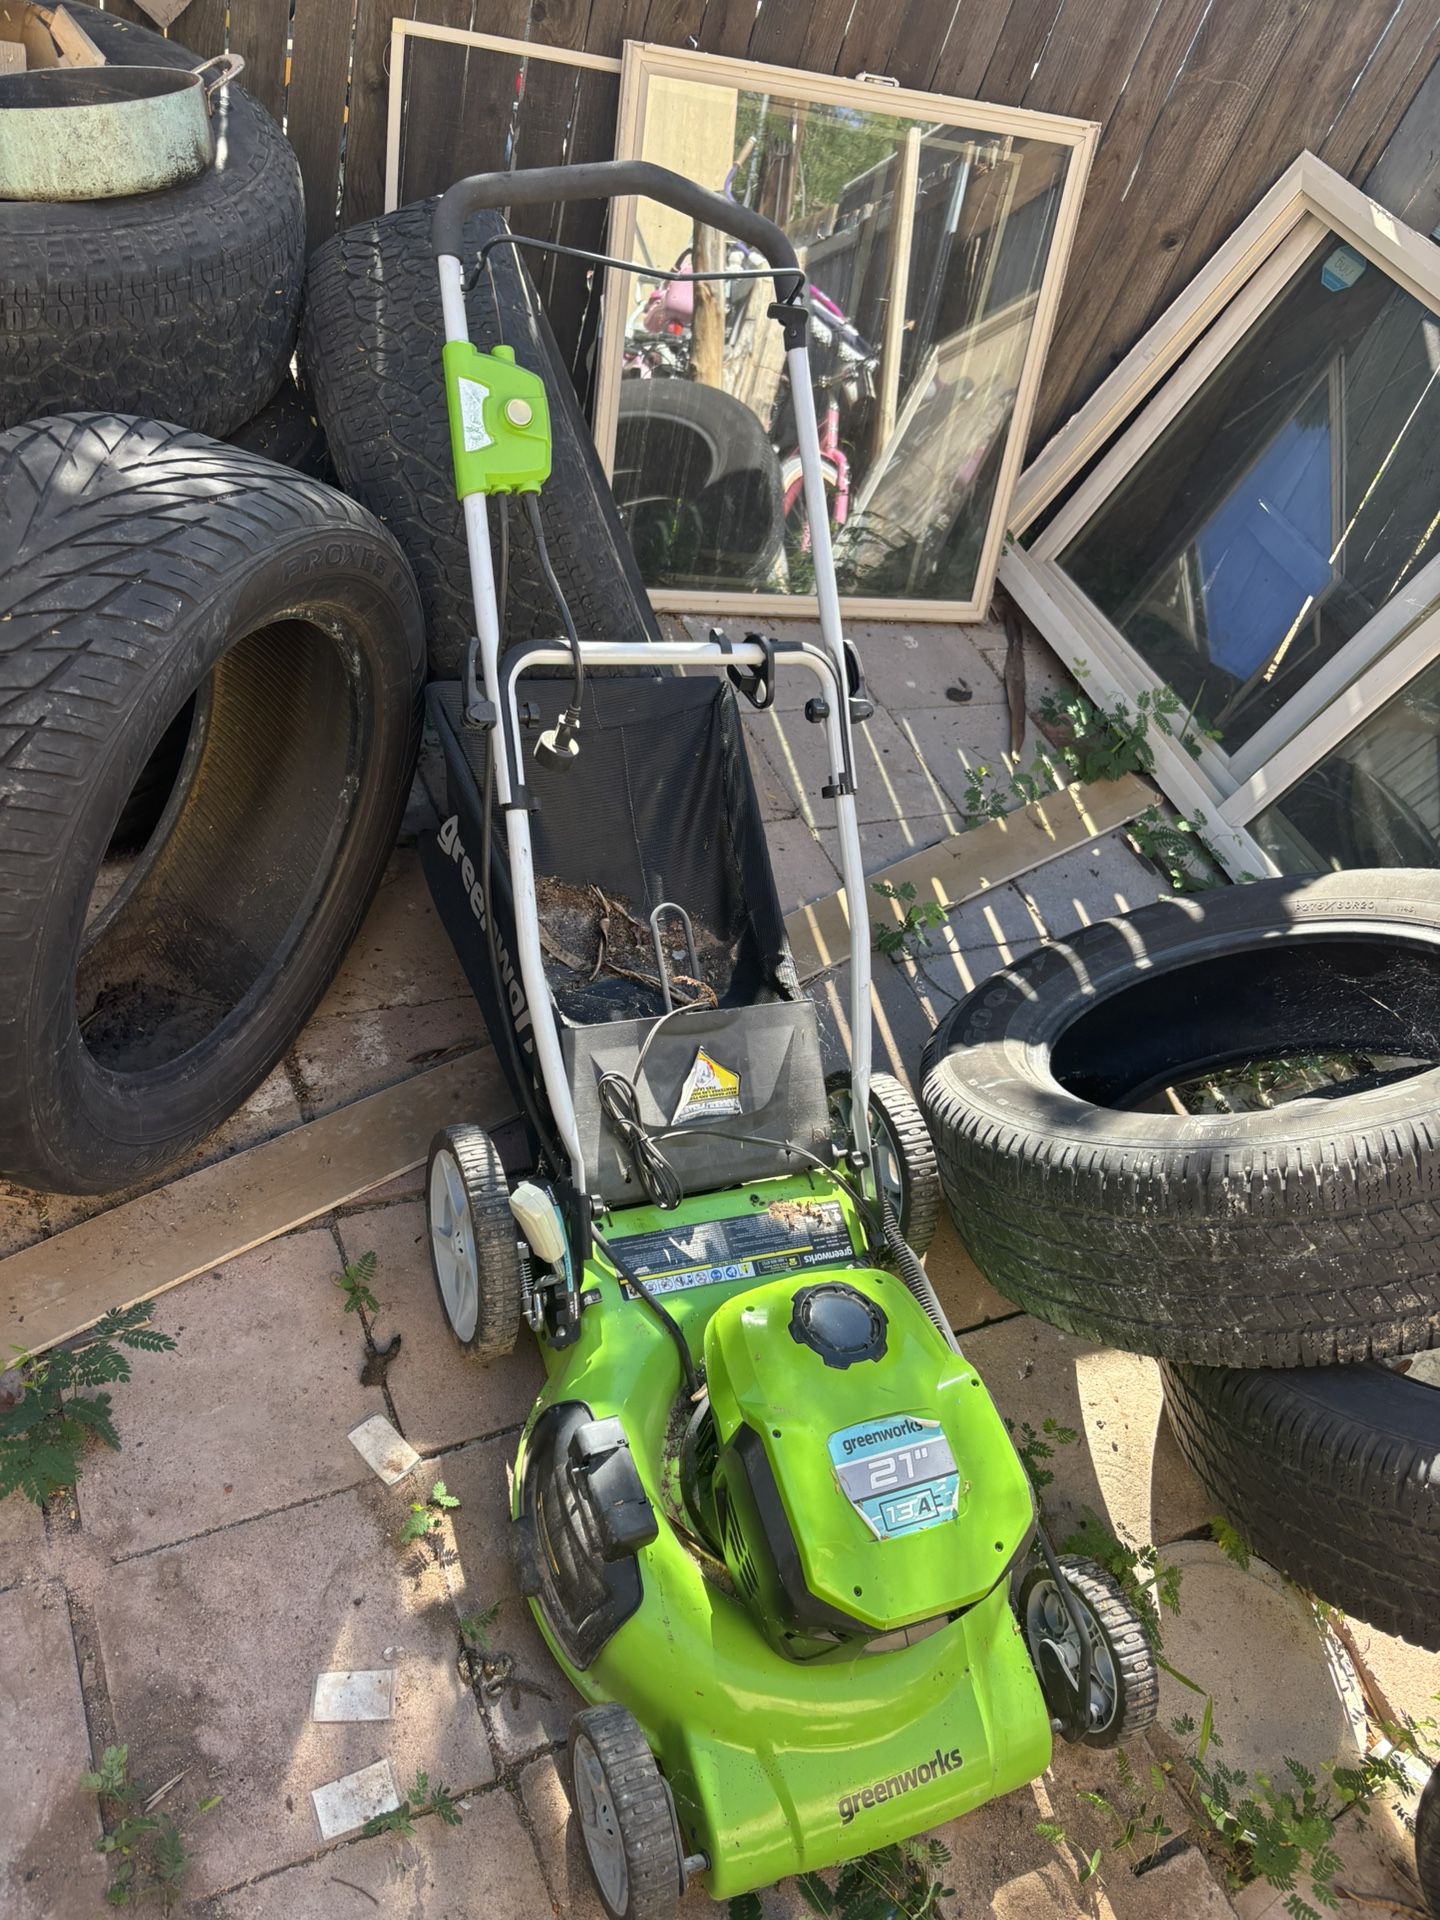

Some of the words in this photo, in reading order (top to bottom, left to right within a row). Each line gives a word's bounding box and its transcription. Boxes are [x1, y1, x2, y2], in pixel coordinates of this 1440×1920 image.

[281, 542, 388, 584] PROXES
[803, 1245, 853, 1265] greenworks
[842, 1419, 923, 1455] greenworks
[867, 1447, 929, 1490] 21"
[885, 1493, 931, 1523] 13A
[838, 1748, 963, 1826] greenworks
